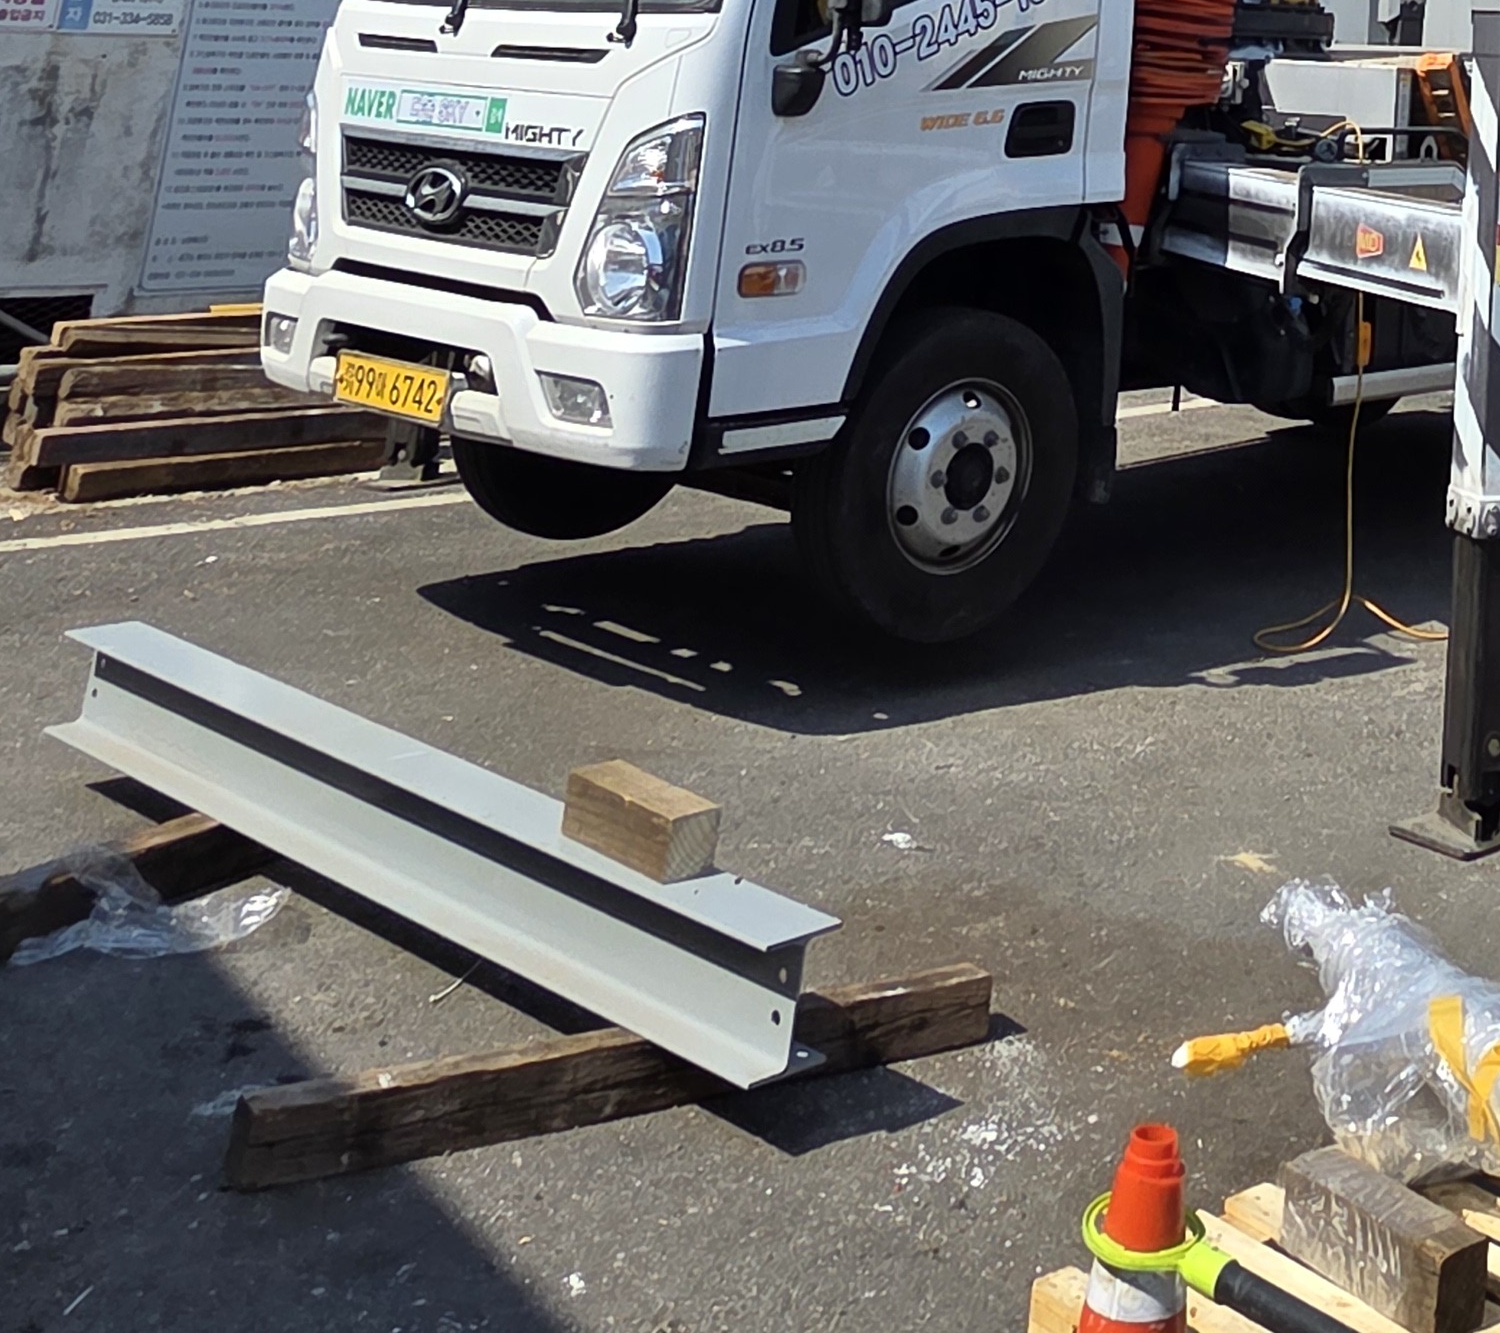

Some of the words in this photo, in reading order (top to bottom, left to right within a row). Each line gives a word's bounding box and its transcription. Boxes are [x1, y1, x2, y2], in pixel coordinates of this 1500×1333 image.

[1018, 65, 1084, 81] MIGHTY
[344, 87, 397, 120] NAVER
[505, 122, 584, 148] MIGHTY
[389, 373, 437, 414] 6742
